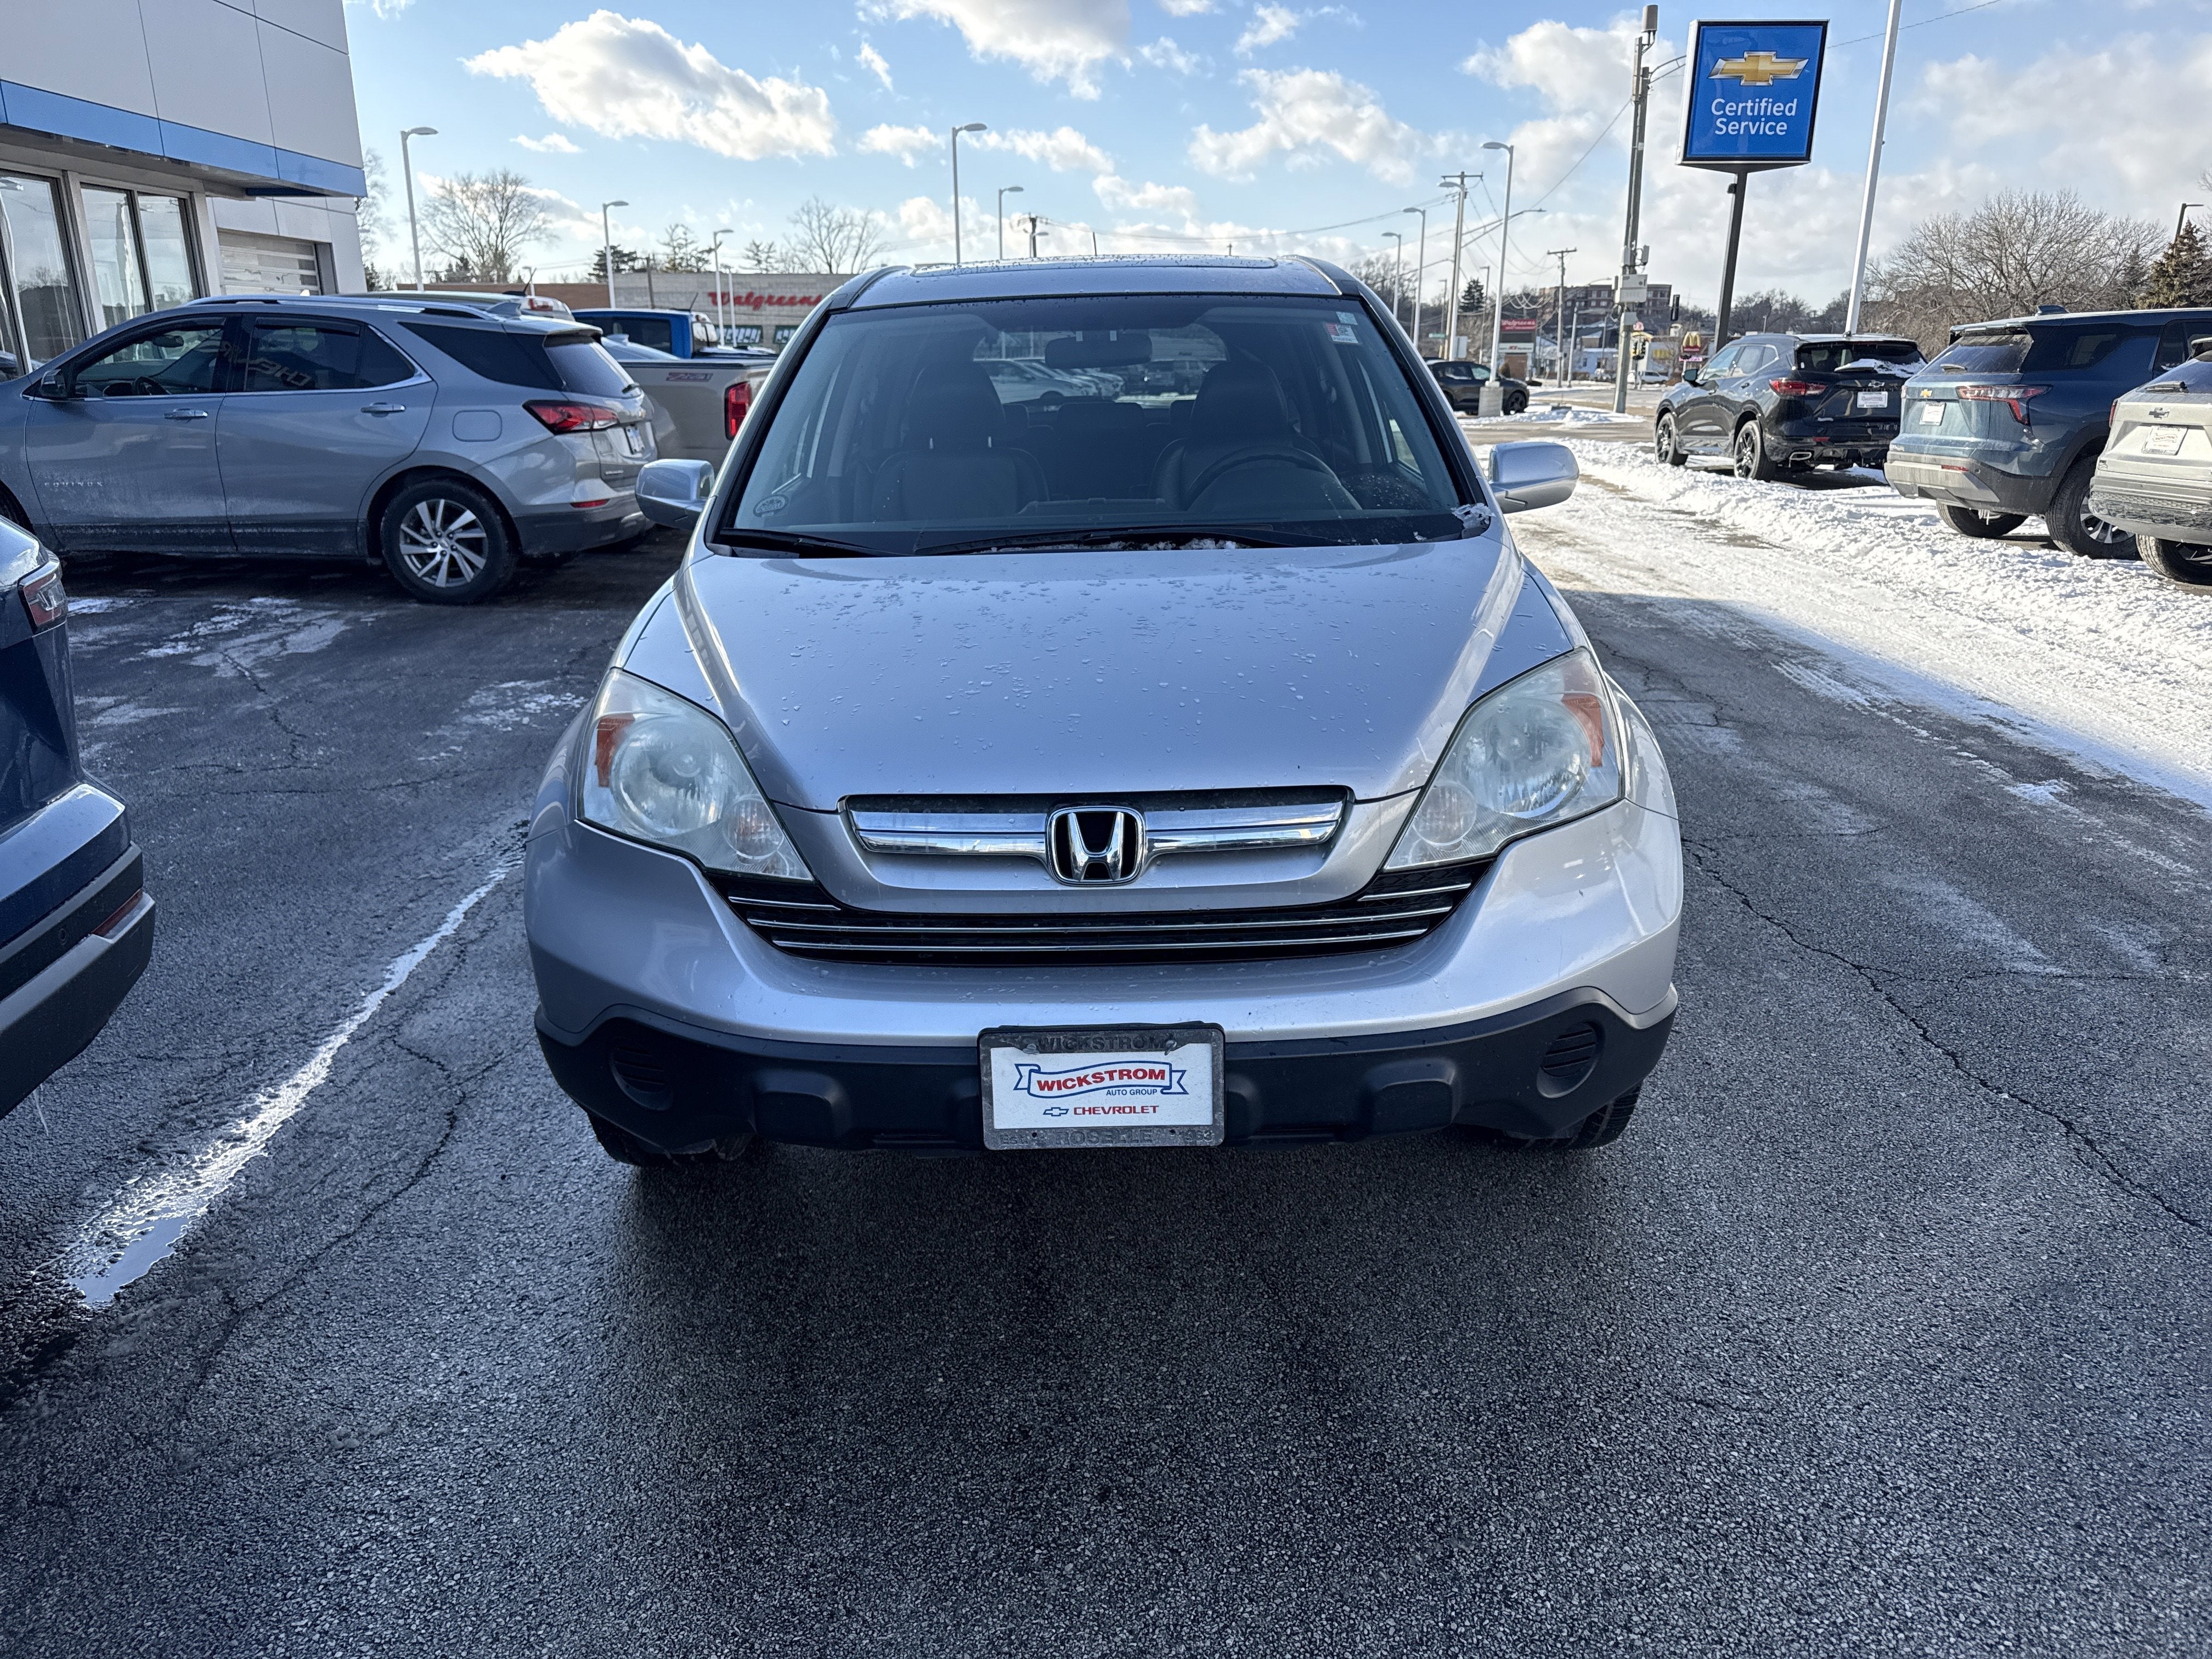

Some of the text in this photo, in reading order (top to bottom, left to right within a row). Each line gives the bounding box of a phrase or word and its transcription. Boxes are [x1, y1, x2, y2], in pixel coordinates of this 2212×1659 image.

[1711, 98, 1798, 116] Certified
[1714, 118, 1787, 136] Service
[708, 290, 822, 311] Walgreens
[1037, 1035, 1168, 1051] WICKSTROM
[1036, 1068, 1166, 1092] WICKSTROM
[1074, 1105, 1160, 1115] CHEVROLET
